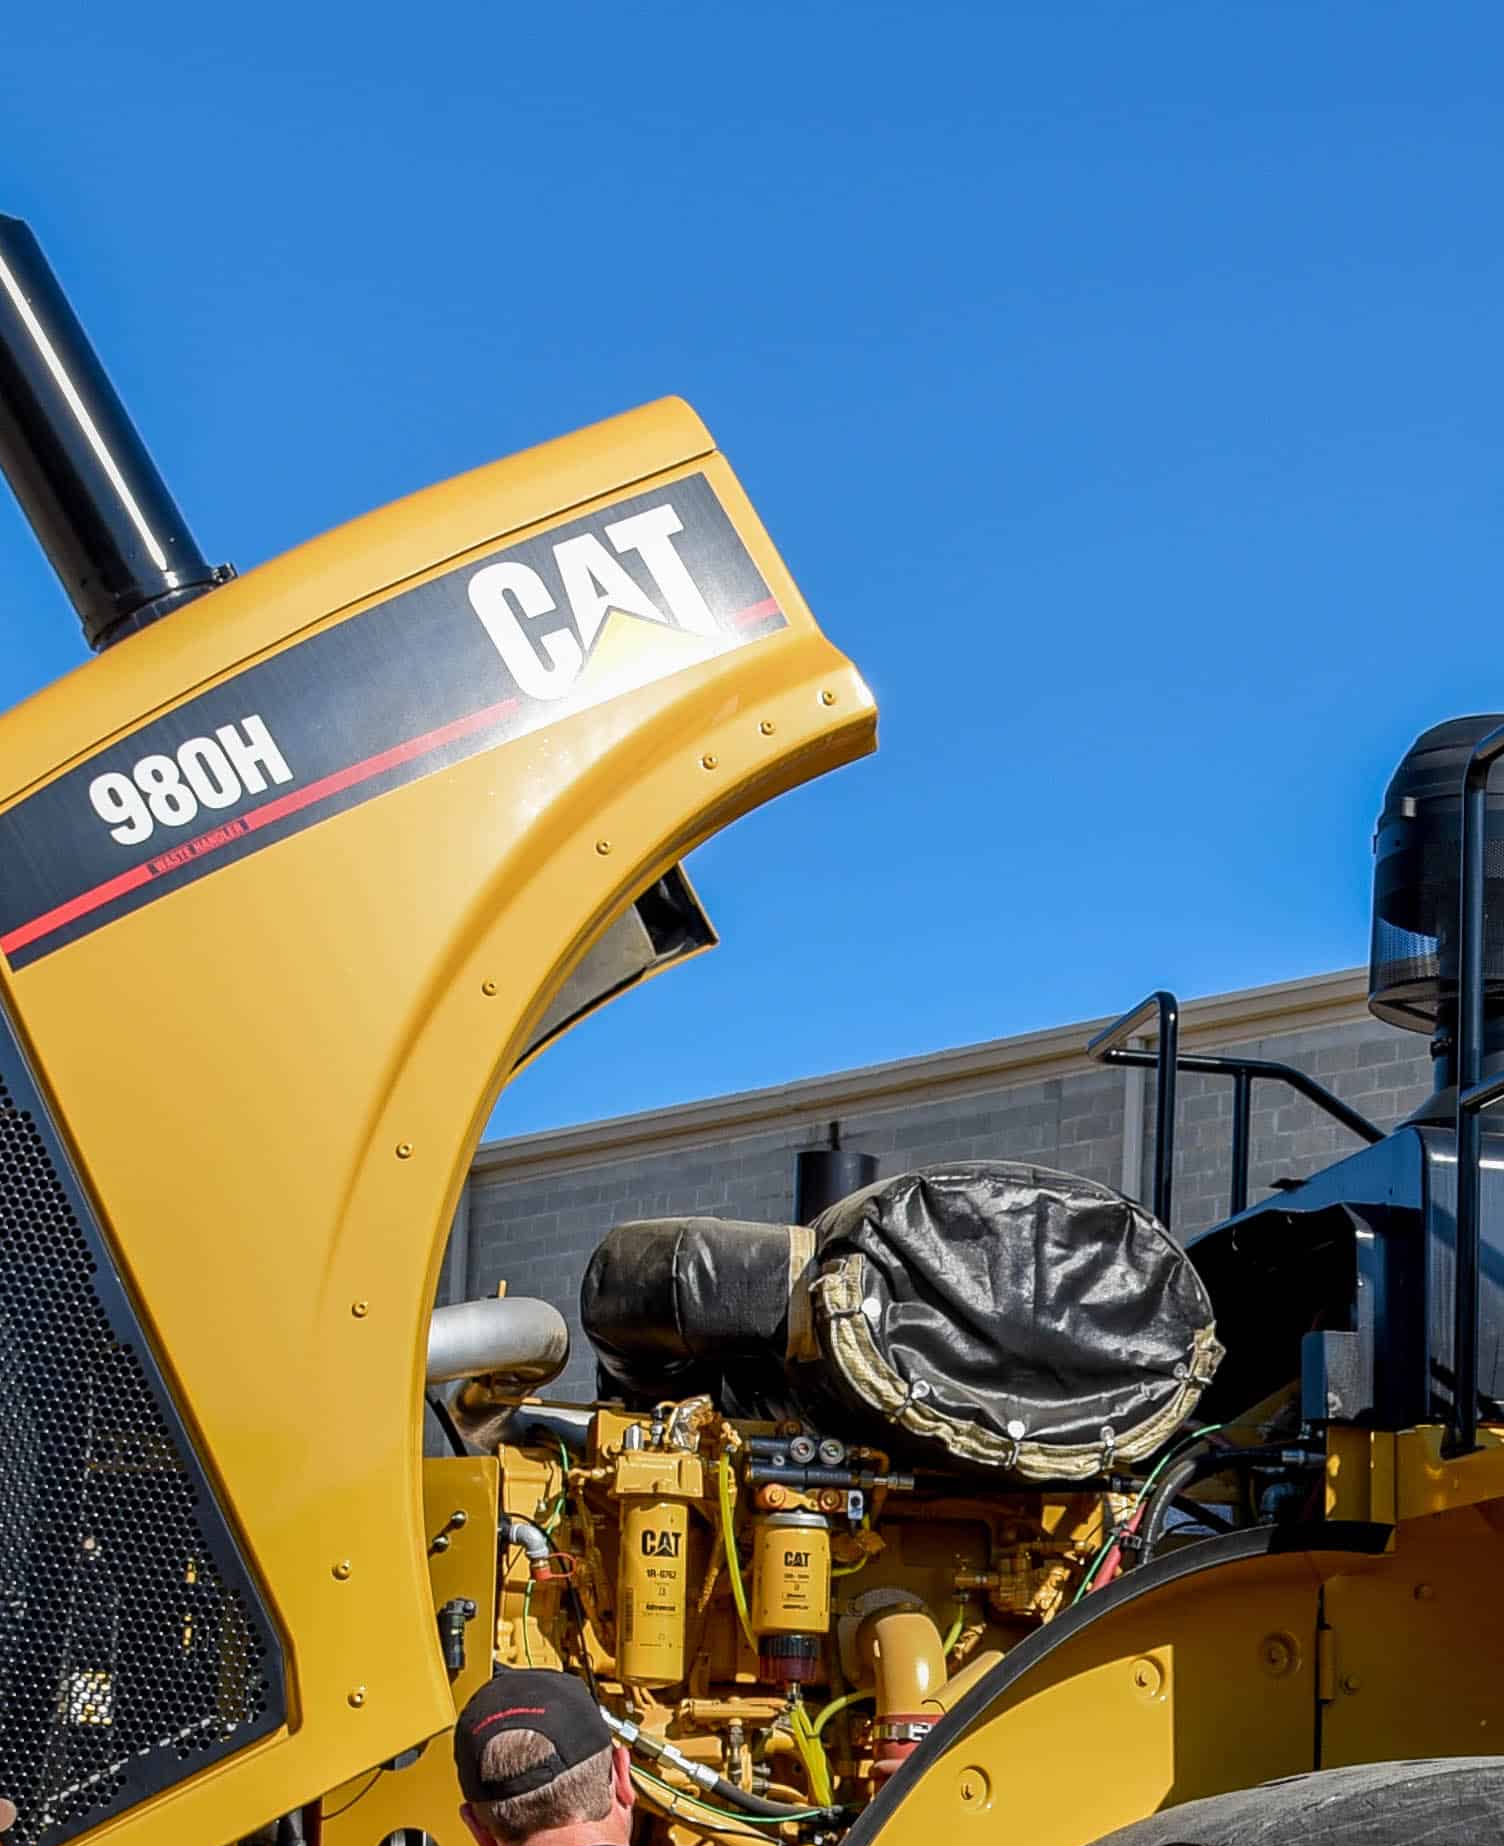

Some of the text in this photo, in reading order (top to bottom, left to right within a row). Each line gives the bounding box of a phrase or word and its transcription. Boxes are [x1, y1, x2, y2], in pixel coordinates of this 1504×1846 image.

[467, 502, 717, 702] CAT
[89, 714, 294, 846] 980H
[153, 844, 192, 875] WASTE
[641, 1529, 682, 1558] CAT
[783, 1551, 811, 1567] CAT
